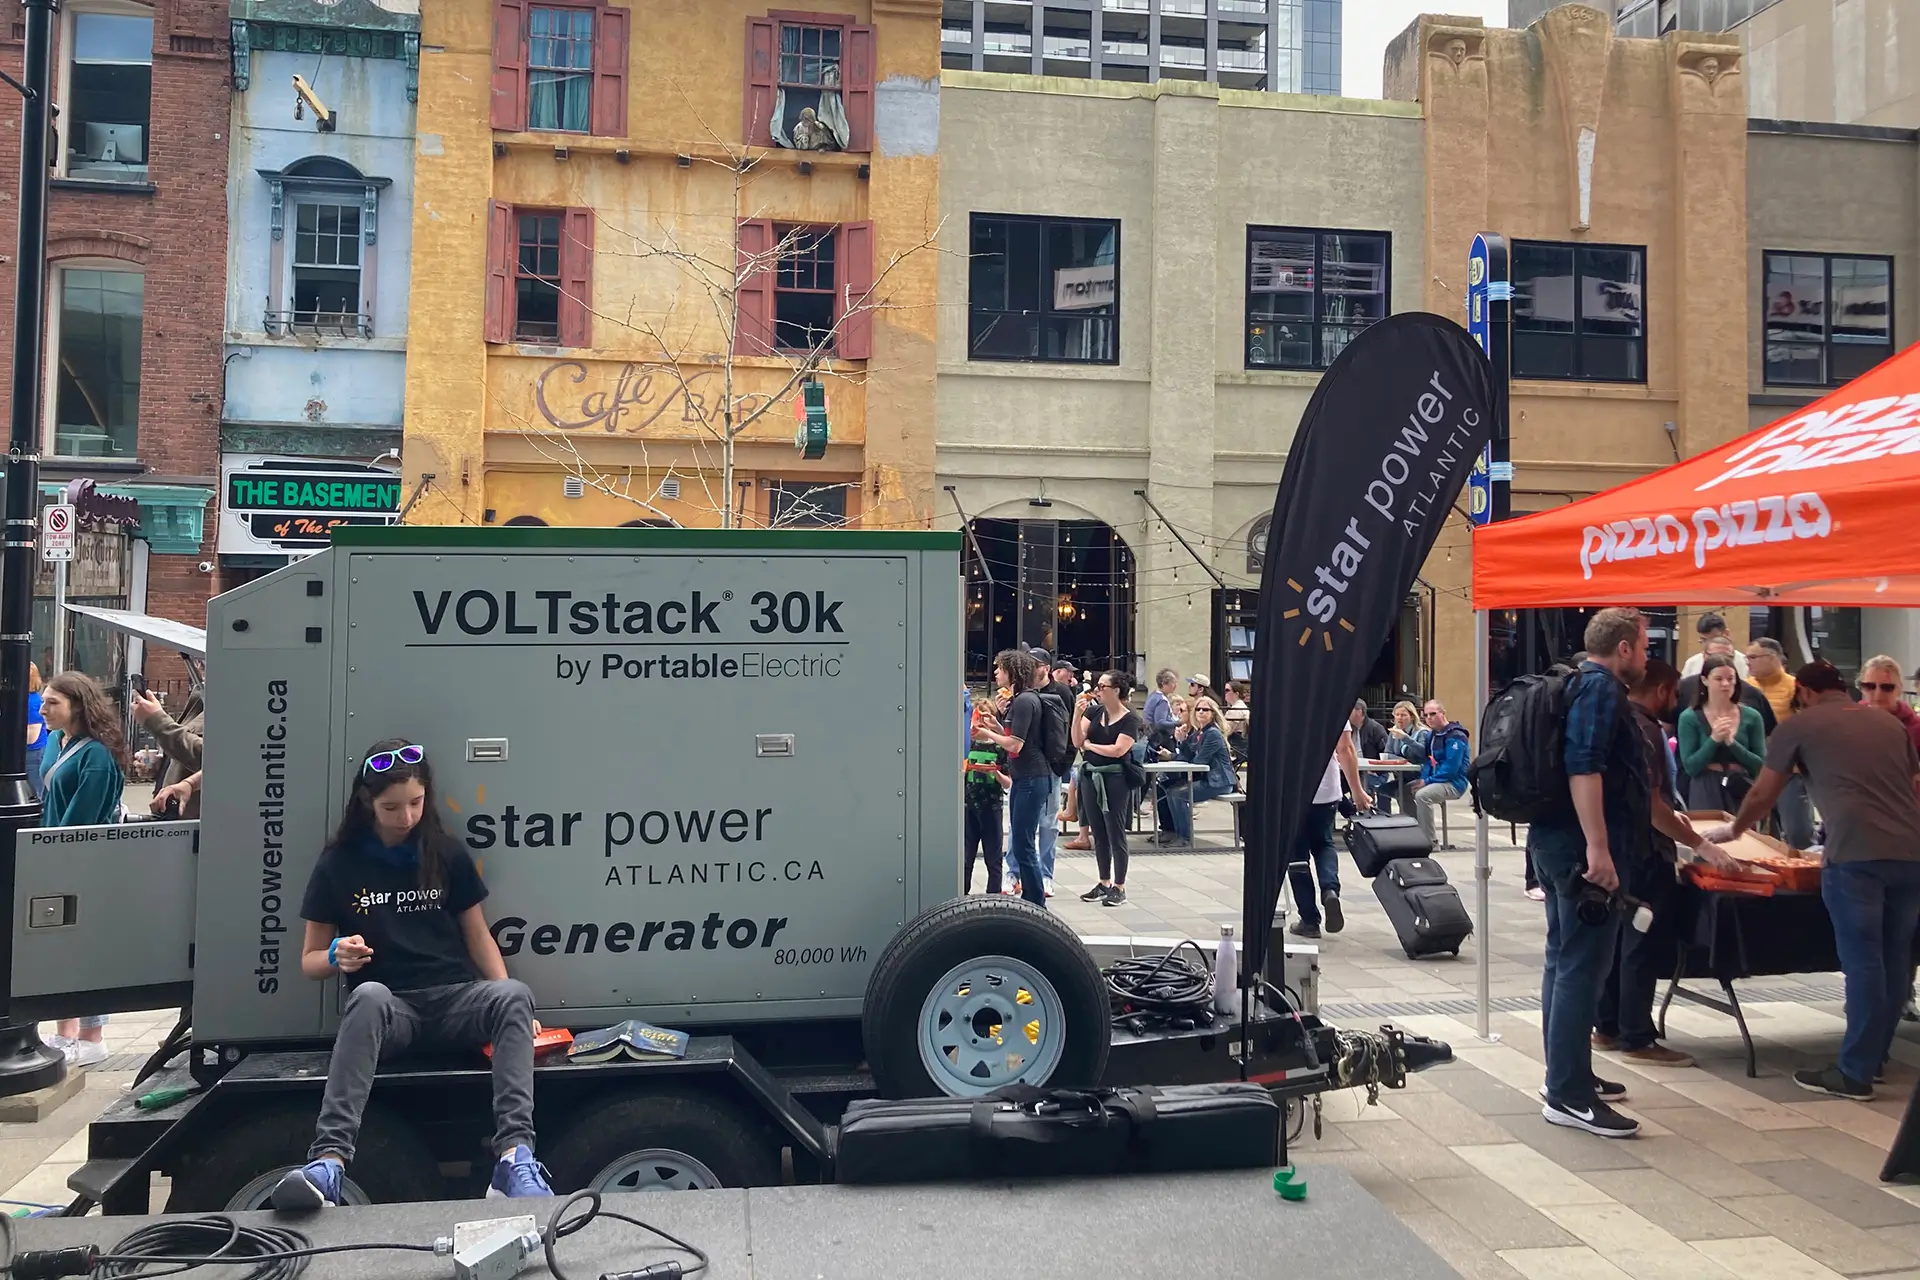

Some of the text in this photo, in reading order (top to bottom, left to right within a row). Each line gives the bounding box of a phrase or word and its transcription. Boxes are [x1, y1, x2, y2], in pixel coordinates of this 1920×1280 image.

[681, 391, 762, 424] BAR
[1725, 392, 1920, 463] pizz
[1402, 407, 1480, 537] ATLANTIC
[233, 480, 401, 508] THE BASEMENT
[1307, 370, 1453, 624] star power
[274, 520, 291, 537] of
[295, 519, 323, 534] The
[1580, 492, 1830, 580] pizza pizza
[749, 591, 844, 634] 30k
[556, 652, 842, 685] by PortableElectric
[254, 679, 288, 994] starpoweratlantic.ca
[465, 806, 772, 857] star power
[604, 860, 825, 886] ATLANTIC.CA
[360, 889, 443, 907] star power
[490, 912, 788, 957] Generator
[774, 946, 867, 965] 80,000 Wh
